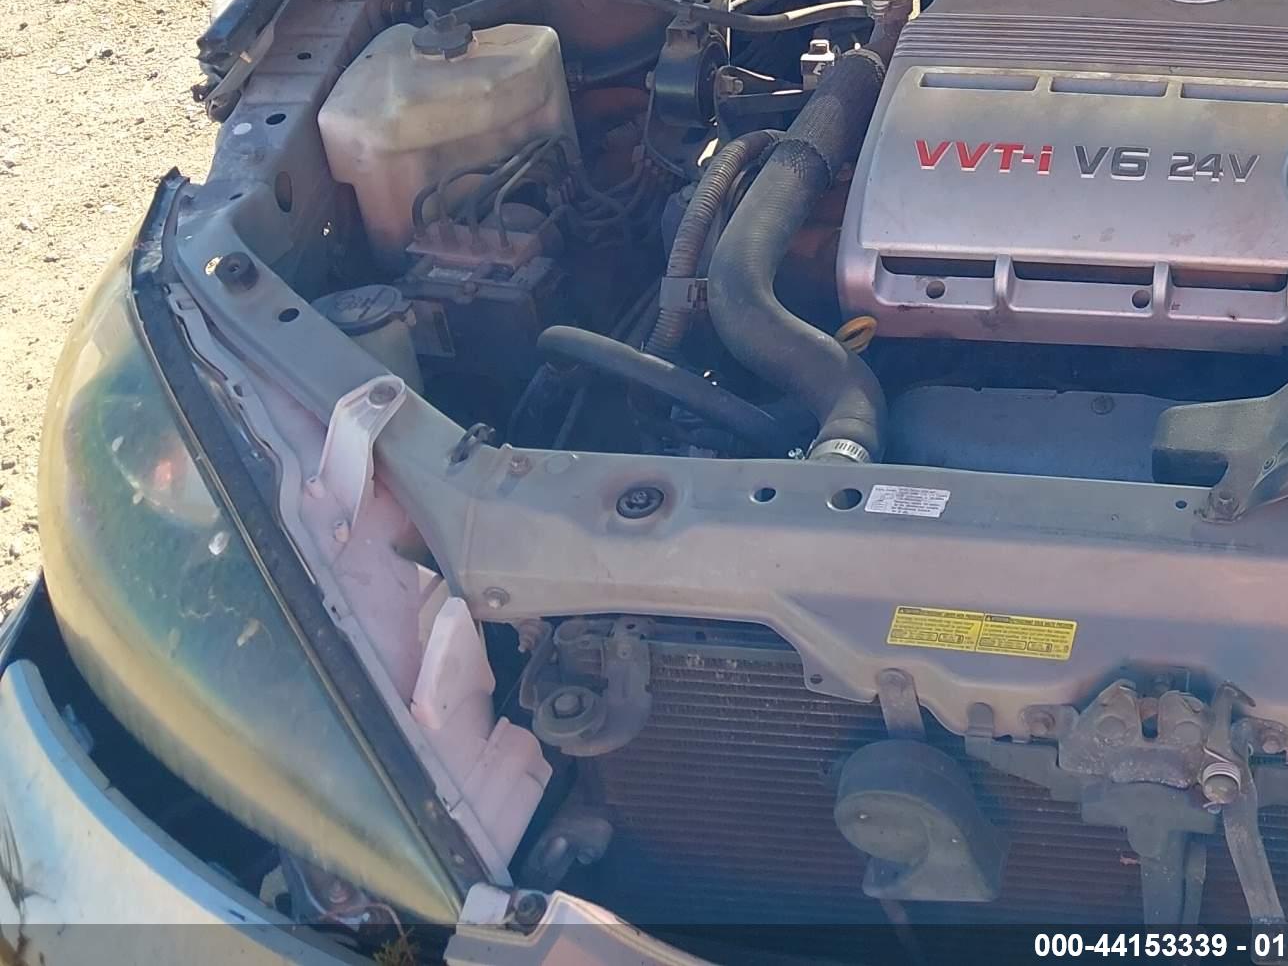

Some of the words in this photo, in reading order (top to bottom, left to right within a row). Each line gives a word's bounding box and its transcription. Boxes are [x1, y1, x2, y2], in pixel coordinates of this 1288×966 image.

[914, 139, 1054, 176] VVT-i
[1073, 145, 1151, 181] V6
[1168, 151, 1260, 183] 24V
